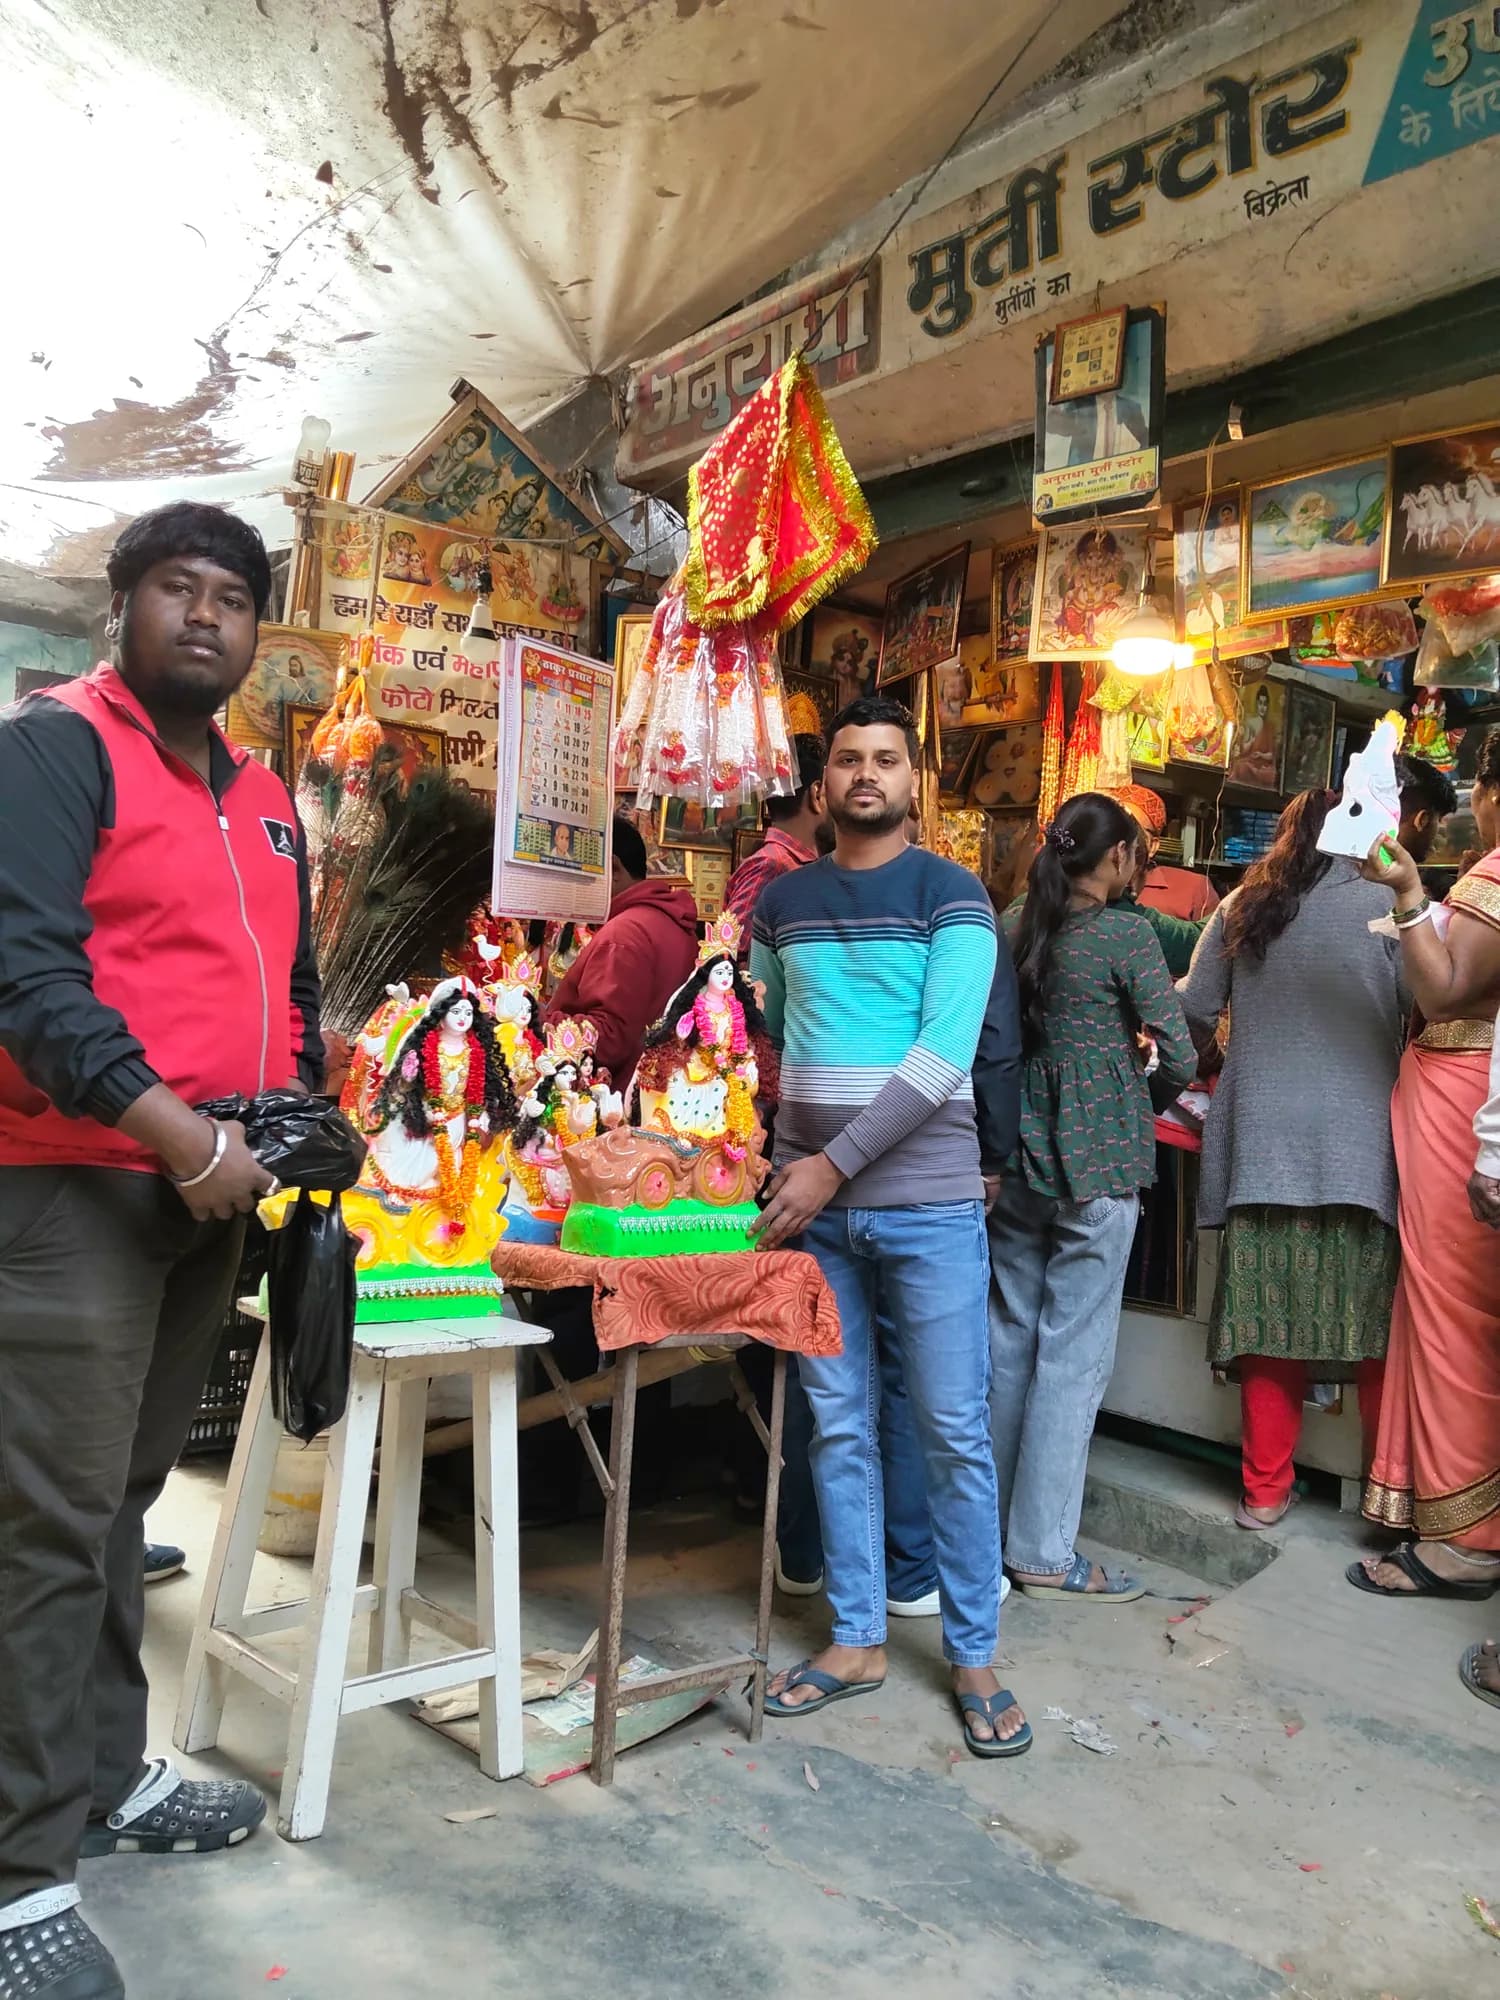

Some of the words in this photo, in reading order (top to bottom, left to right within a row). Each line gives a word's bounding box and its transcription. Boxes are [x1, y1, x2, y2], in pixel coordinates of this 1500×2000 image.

[1087, 37, 1361, 236] स्टोर
[1047, 272, 1071, 296] का
[331, 594, 390, 622] हमरे
[395, 602, 438, 629] यहाँ
[412, 645, 448, 671] एवं
[381, 684, 434, 711] फोटो
